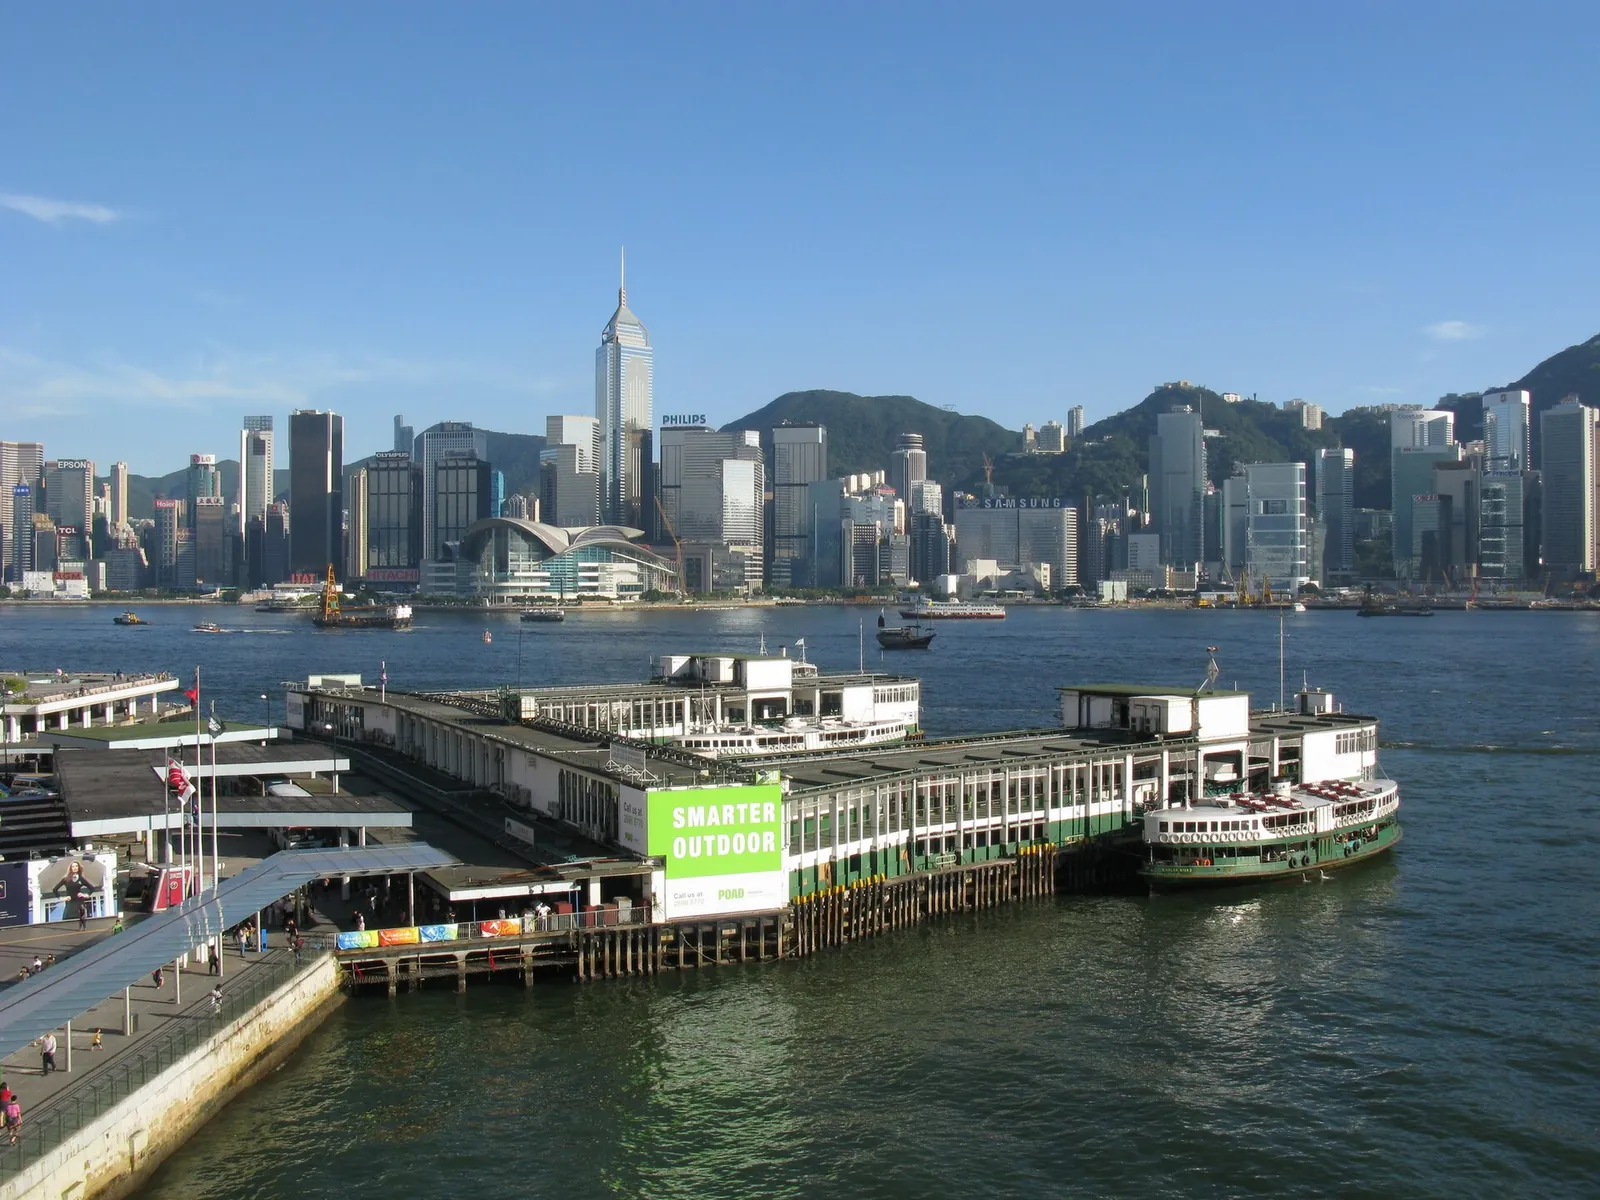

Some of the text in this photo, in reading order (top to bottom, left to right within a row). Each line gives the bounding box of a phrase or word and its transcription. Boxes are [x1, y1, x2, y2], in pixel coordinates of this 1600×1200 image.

[662, 414, 706, 425] PHILIPS
[58, 461, 86, 469] EPSON
[985, 498, 1060, 508] SAMSUNG
[367, 571, 418, 580] HITACHI
[673, 802, 776, 829] SMARTER
[673, 831, 776, 859] OUTDOOR
[718, 888, 744, 900] POAD
